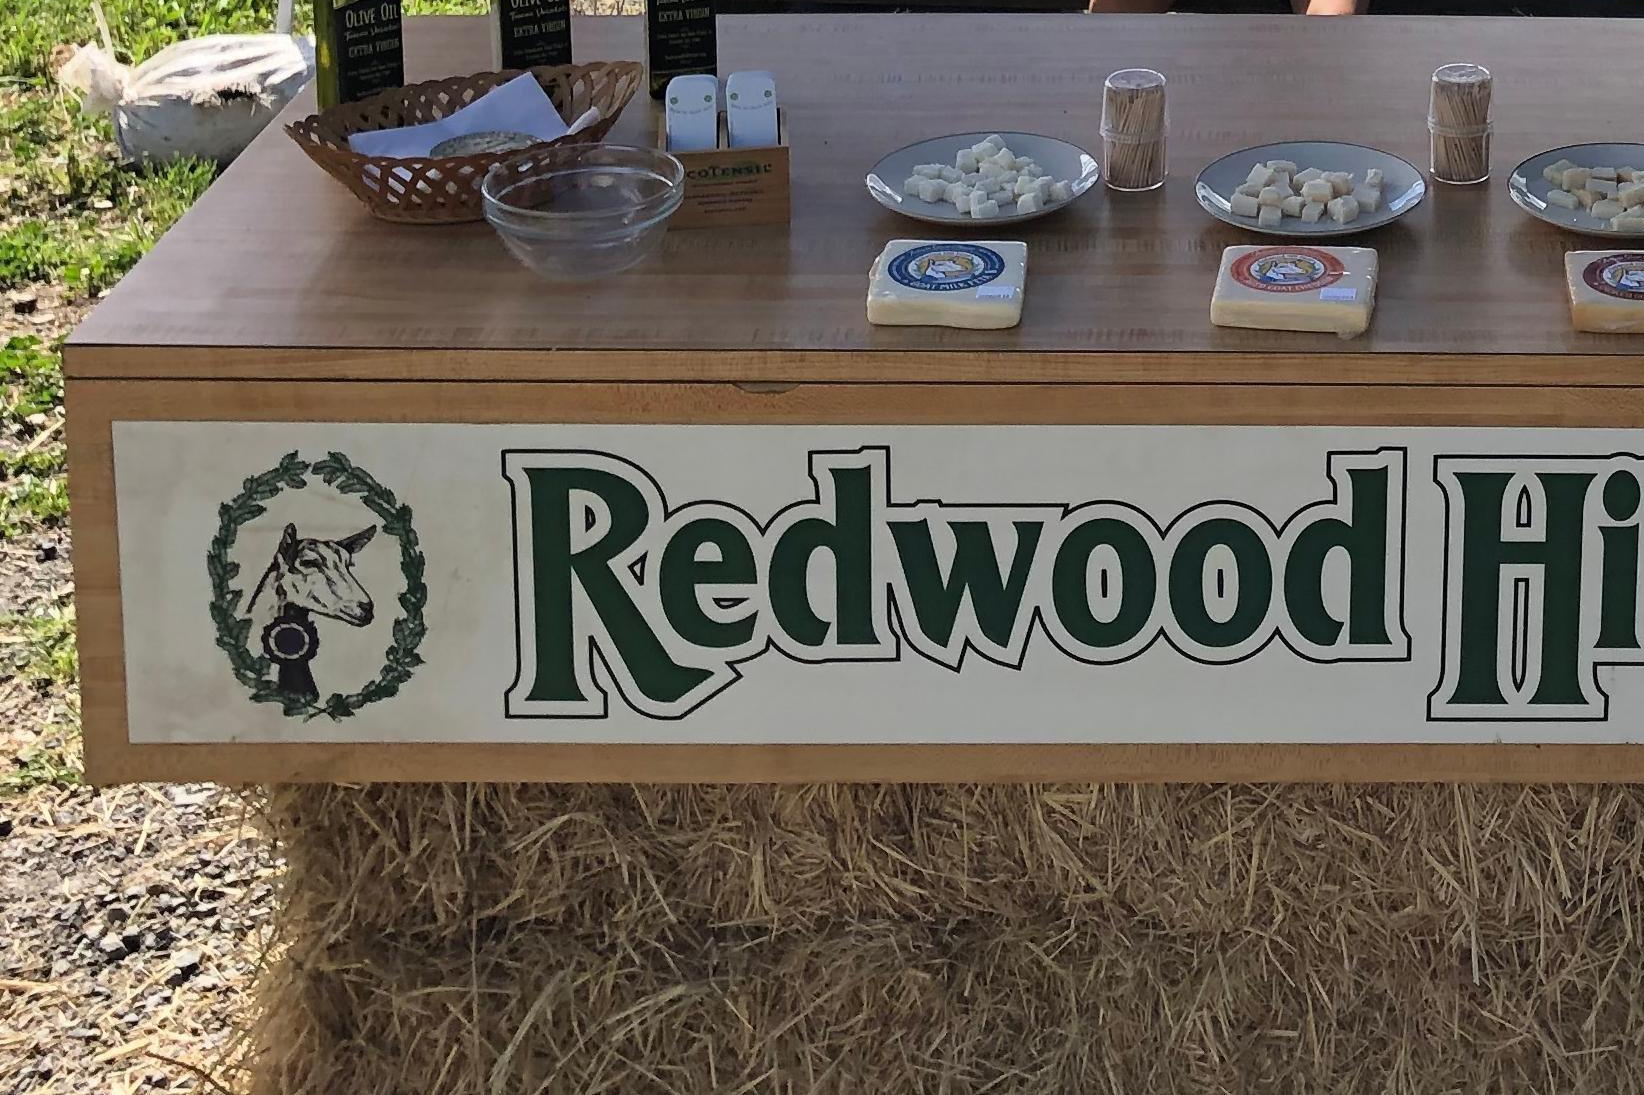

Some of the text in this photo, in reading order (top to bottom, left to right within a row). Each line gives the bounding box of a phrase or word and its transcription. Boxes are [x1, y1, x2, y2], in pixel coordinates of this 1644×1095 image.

[345, 2, 399, 29] OLIVE OIL
[502, 446, 1412, 720] Redwood
